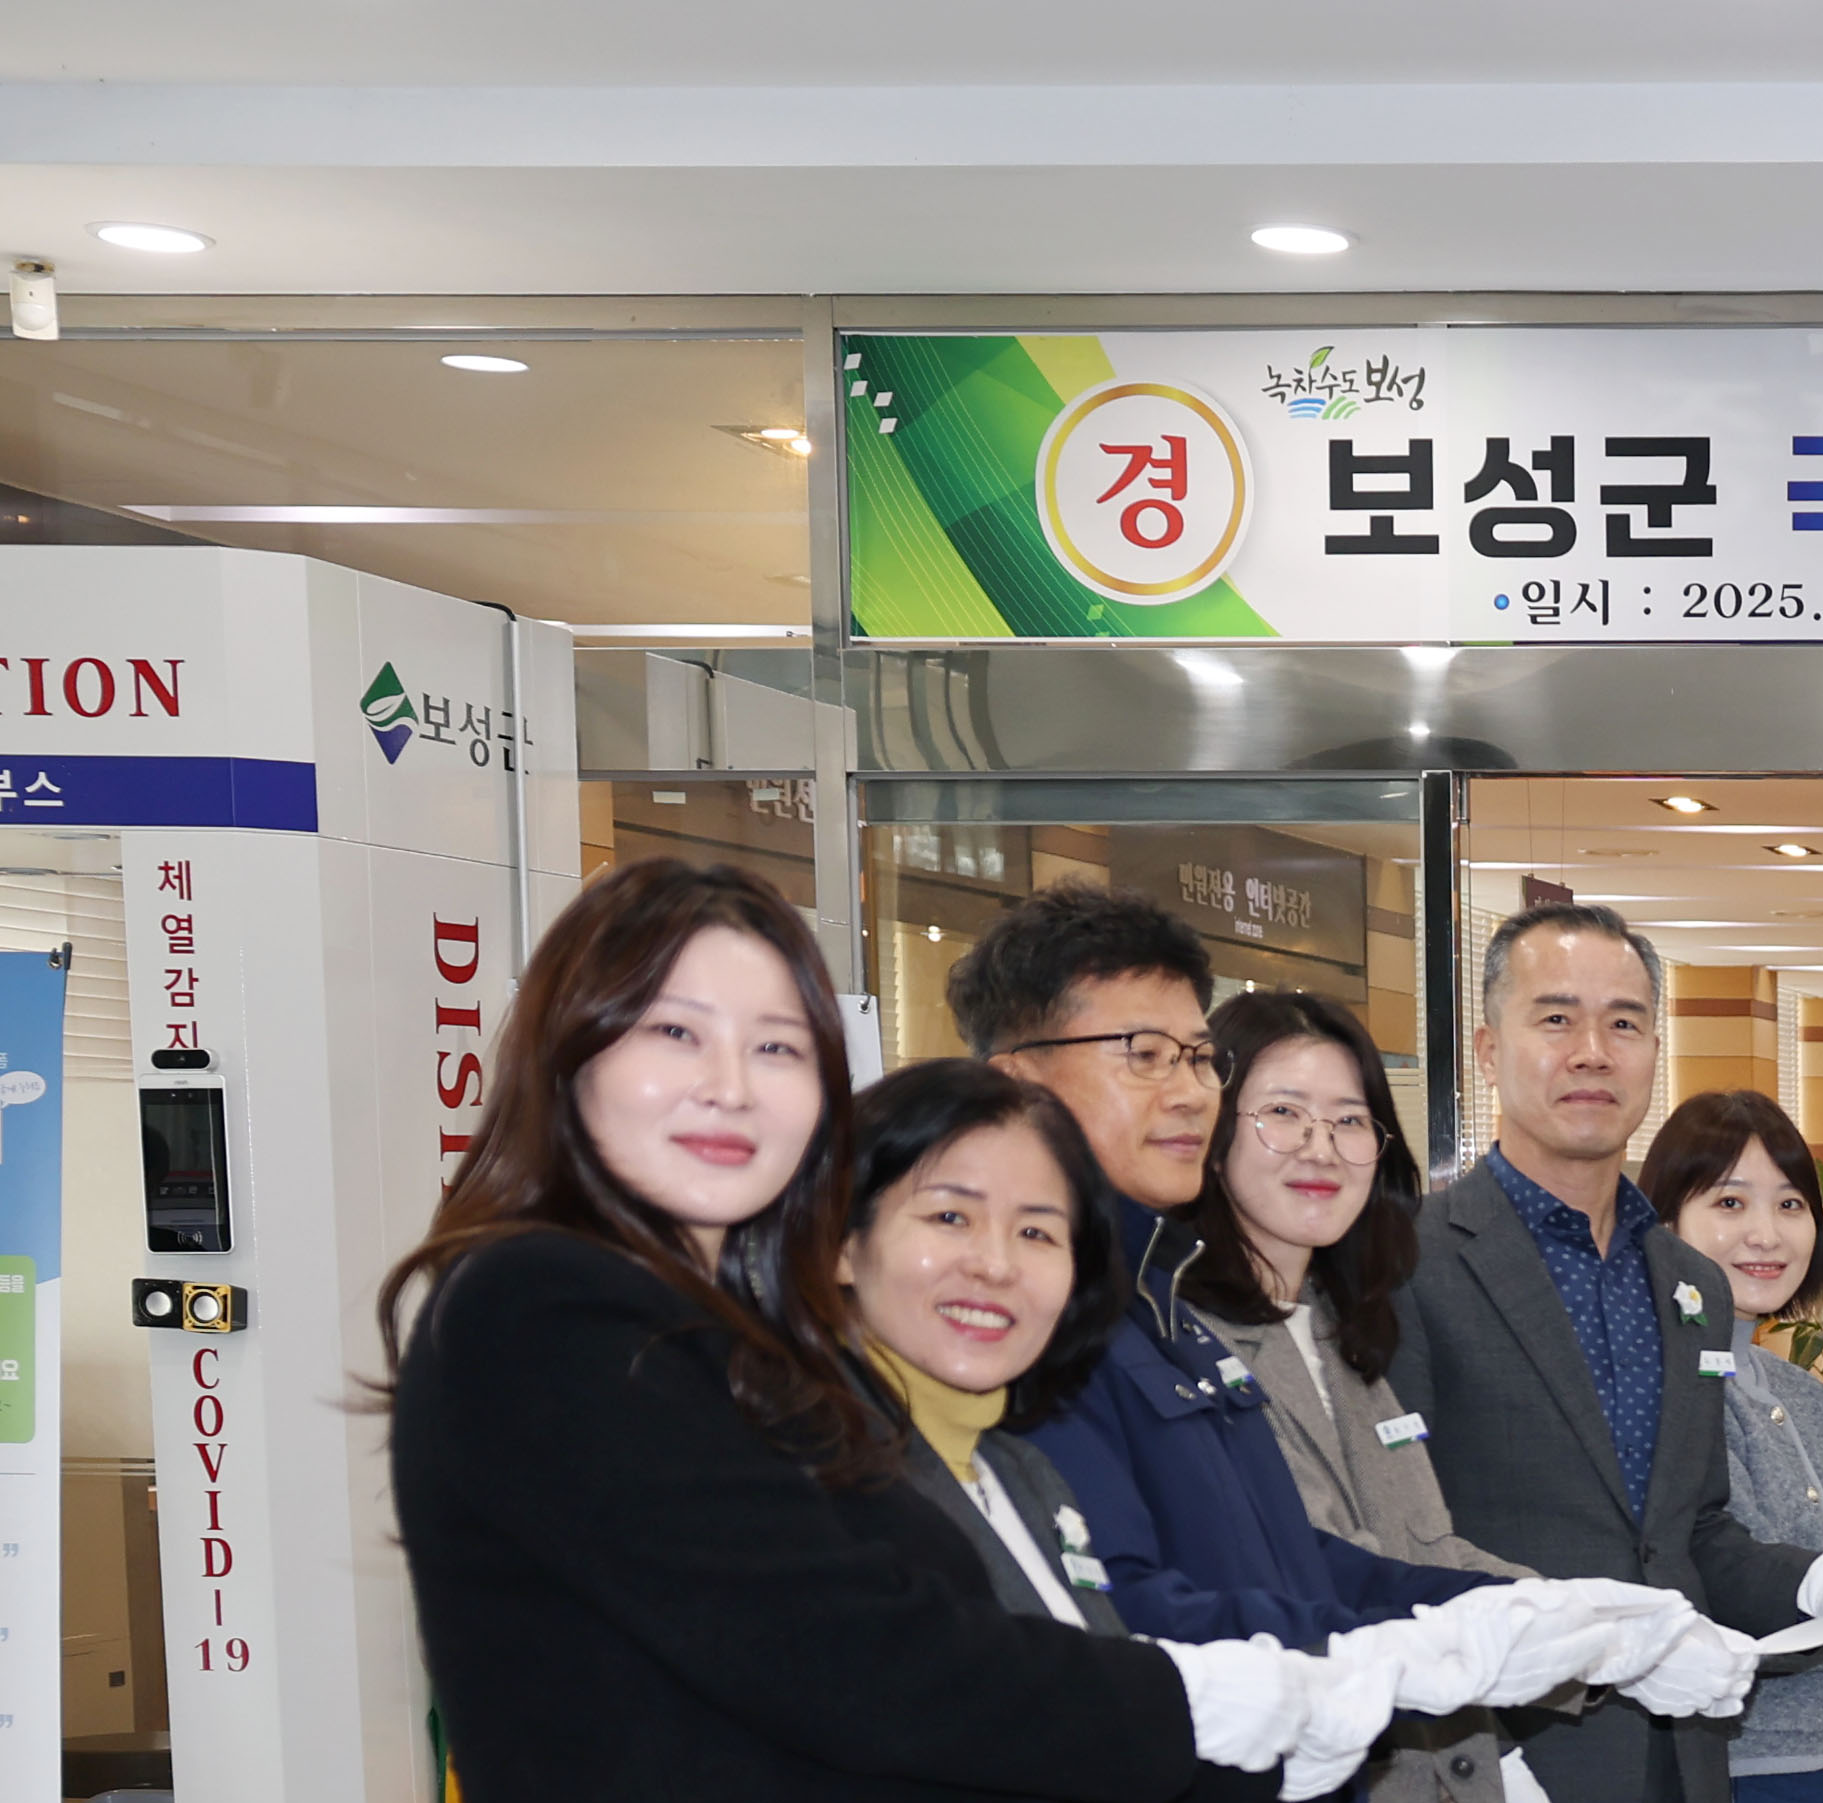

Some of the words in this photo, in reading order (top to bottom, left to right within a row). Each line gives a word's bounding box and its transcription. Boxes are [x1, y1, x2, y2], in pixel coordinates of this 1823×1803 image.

[1260, 352, 1361, 400] 녹차수도
[1364, 355, 1426, 411] 보성
[1096, 435, 1189, 549] 경
[1325, 435, 1717, 558] 보성군
[1522, 579, 1611, 626] 일시
[1682, 582, 1822, 622] 2025.
[0, 656, 186, 718] ION
